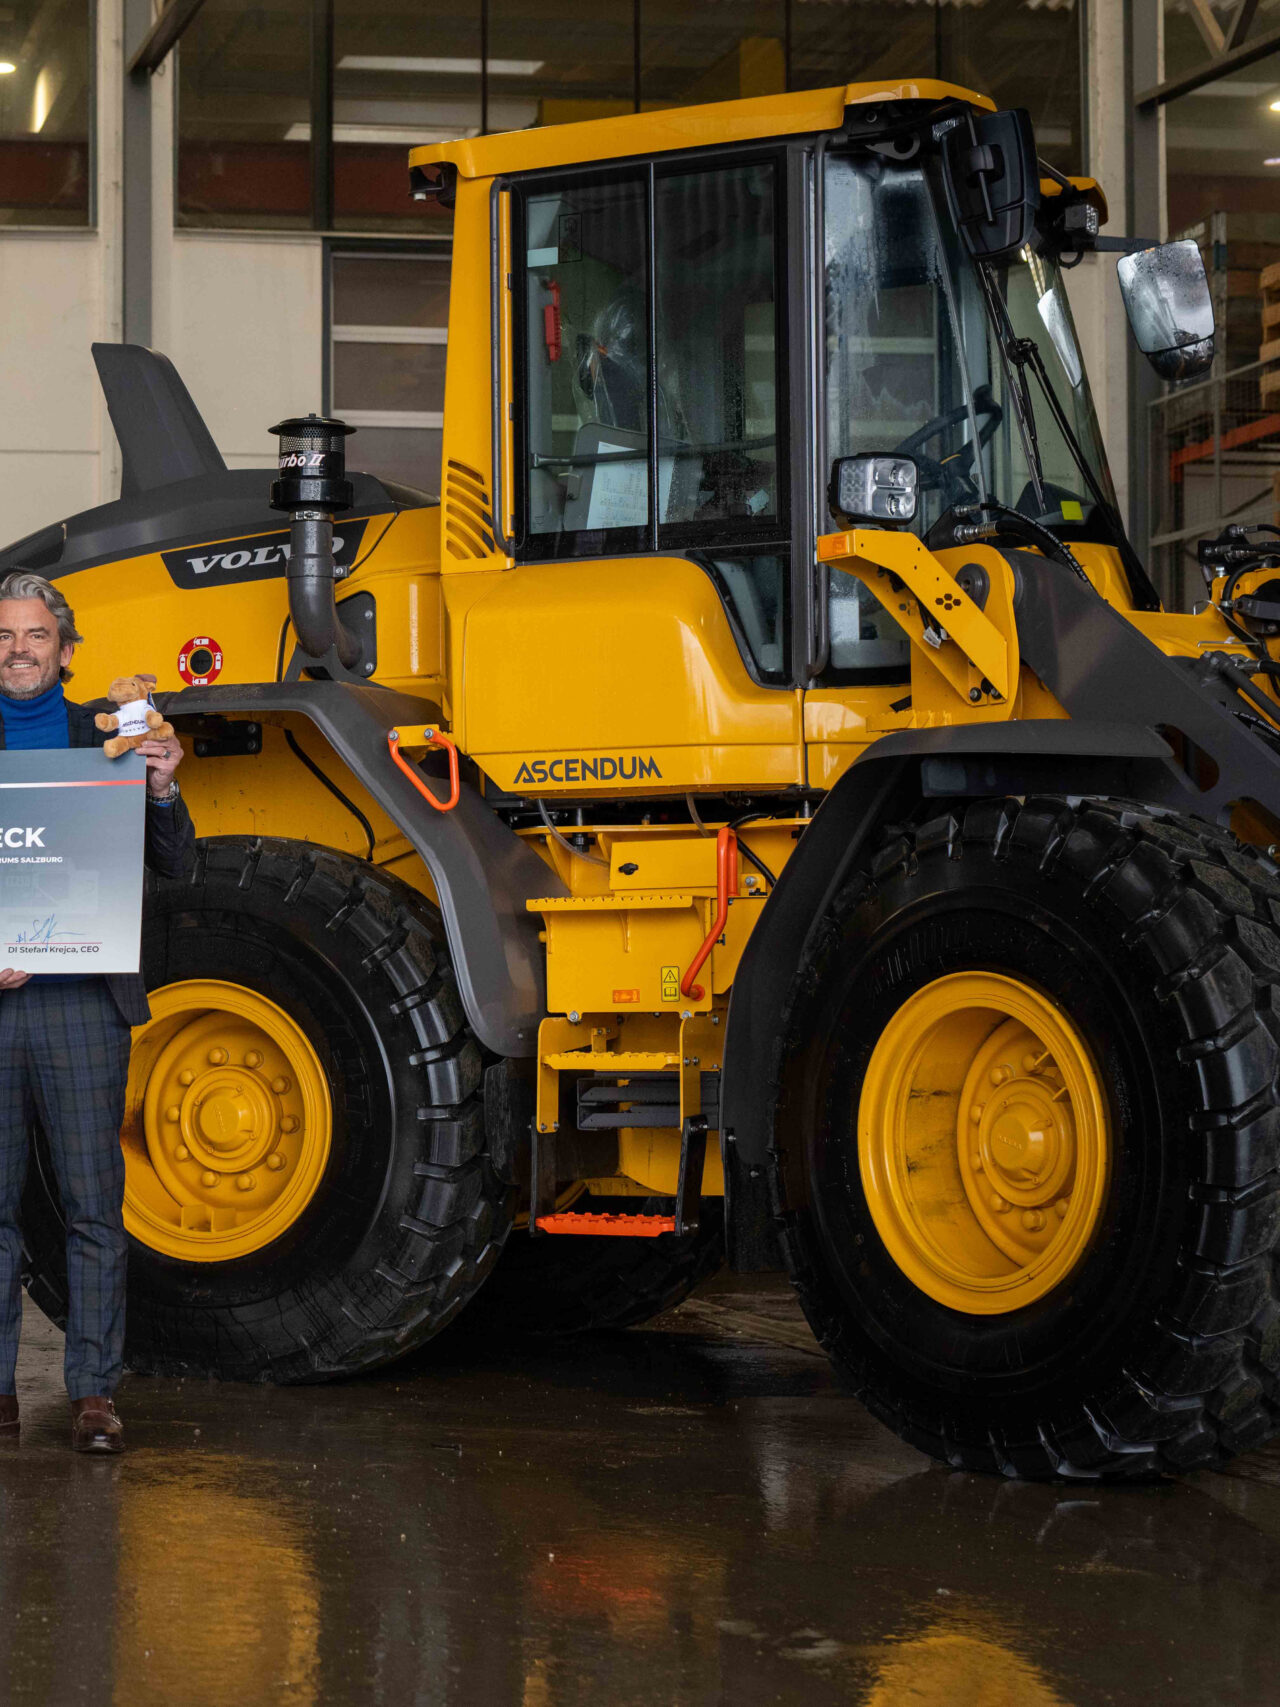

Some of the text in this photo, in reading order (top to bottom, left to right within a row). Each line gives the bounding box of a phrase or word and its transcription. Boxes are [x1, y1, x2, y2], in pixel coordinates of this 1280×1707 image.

[280, 453, 307, 468] urbo
[187, 537, 345, 574] VOL
[513, 755, 663, 784] ASCENDUM
[20, 856, 63, 864] SALZBURG
[49, 945, 78, 955] Krejca,
[80, 945, 100, 953] CEO
